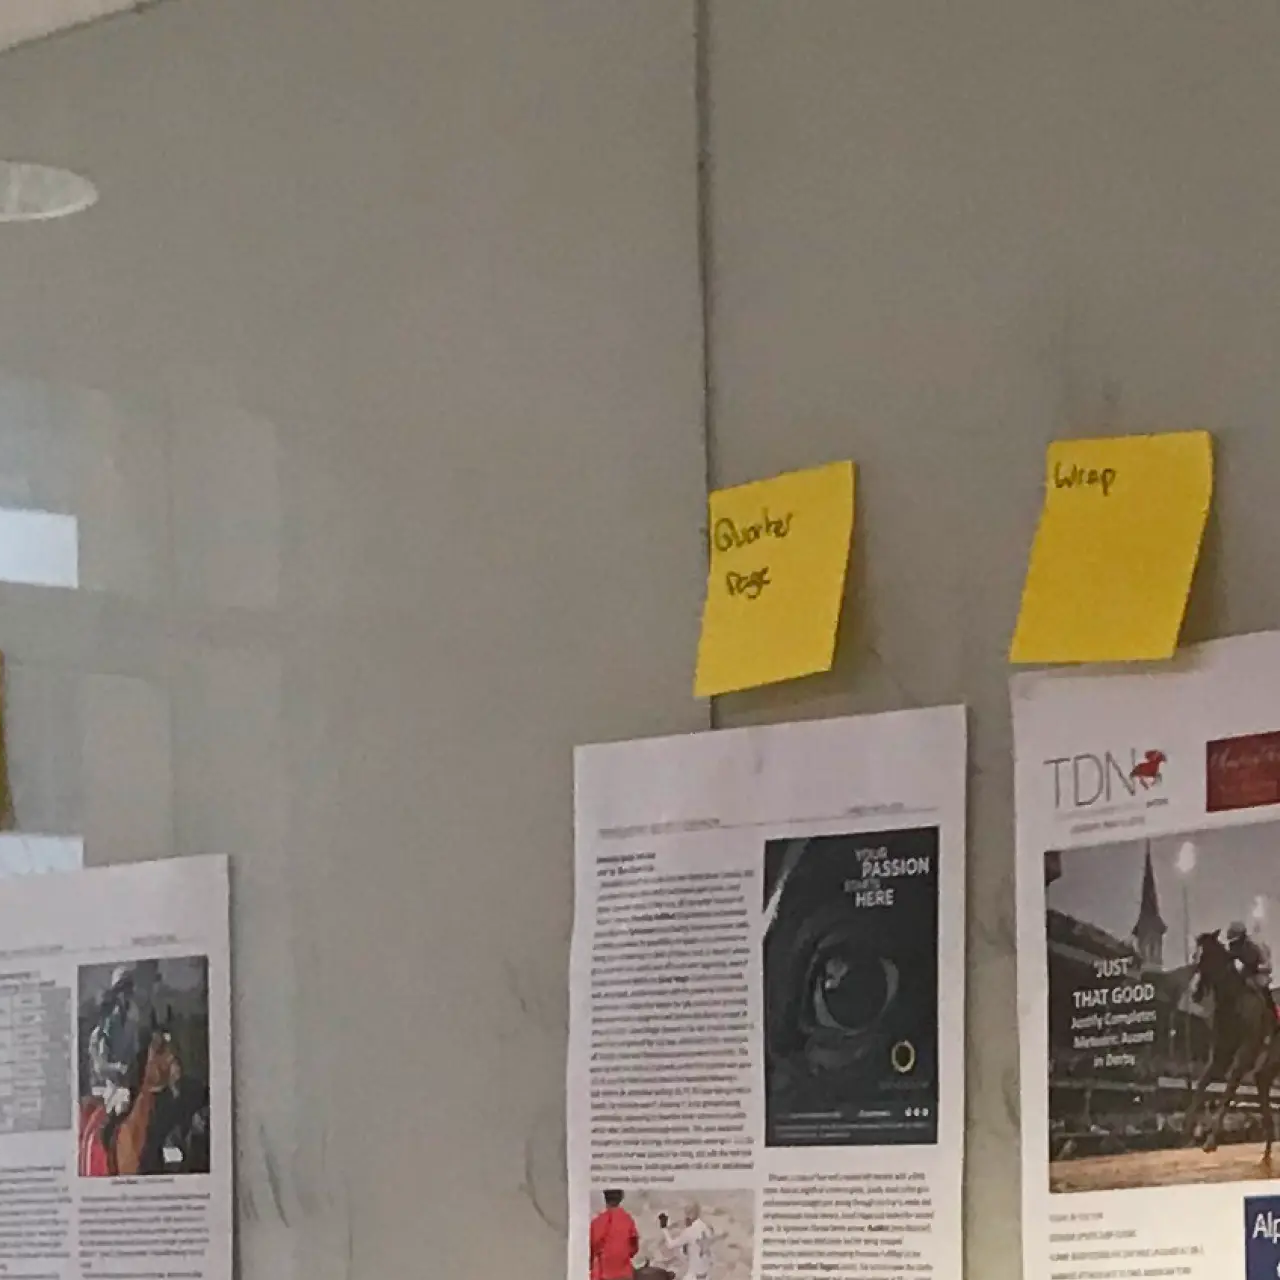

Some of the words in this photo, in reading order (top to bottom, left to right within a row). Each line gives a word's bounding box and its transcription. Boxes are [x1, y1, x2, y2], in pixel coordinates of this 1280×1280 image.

[1043, 748, 1136, 809] TDN
[862, 856, 930, 878] PASSION
[855, 888, 895, 908] HERE
[1072, 989, 1109, 1008] THAT
[1111, 983, 1155, 1004] GOOD
